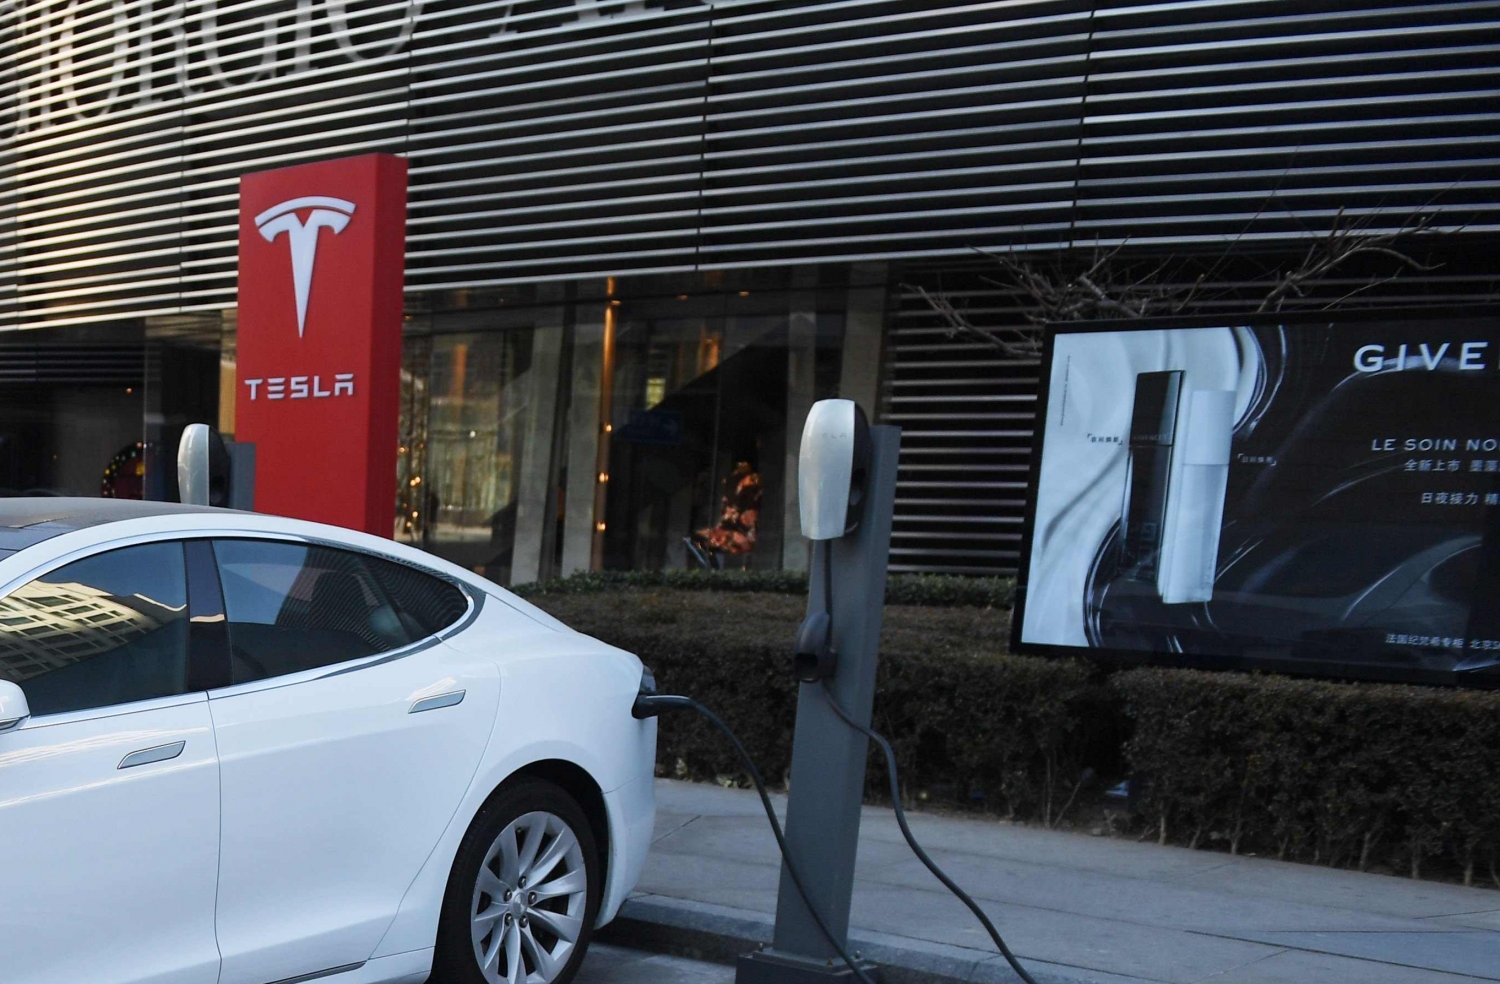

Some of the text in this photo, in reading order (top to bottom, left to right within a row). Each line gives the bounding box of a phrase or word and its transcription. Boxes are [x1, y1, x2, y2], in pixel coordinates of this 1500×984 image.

[1353, 341, 1500, 373] GIVE
[244, 373, 354, 401] TESLA
[1371, 438, 1500, 452] LE SOIN NO
[1404, 458, 1461, 472] 全新上市
